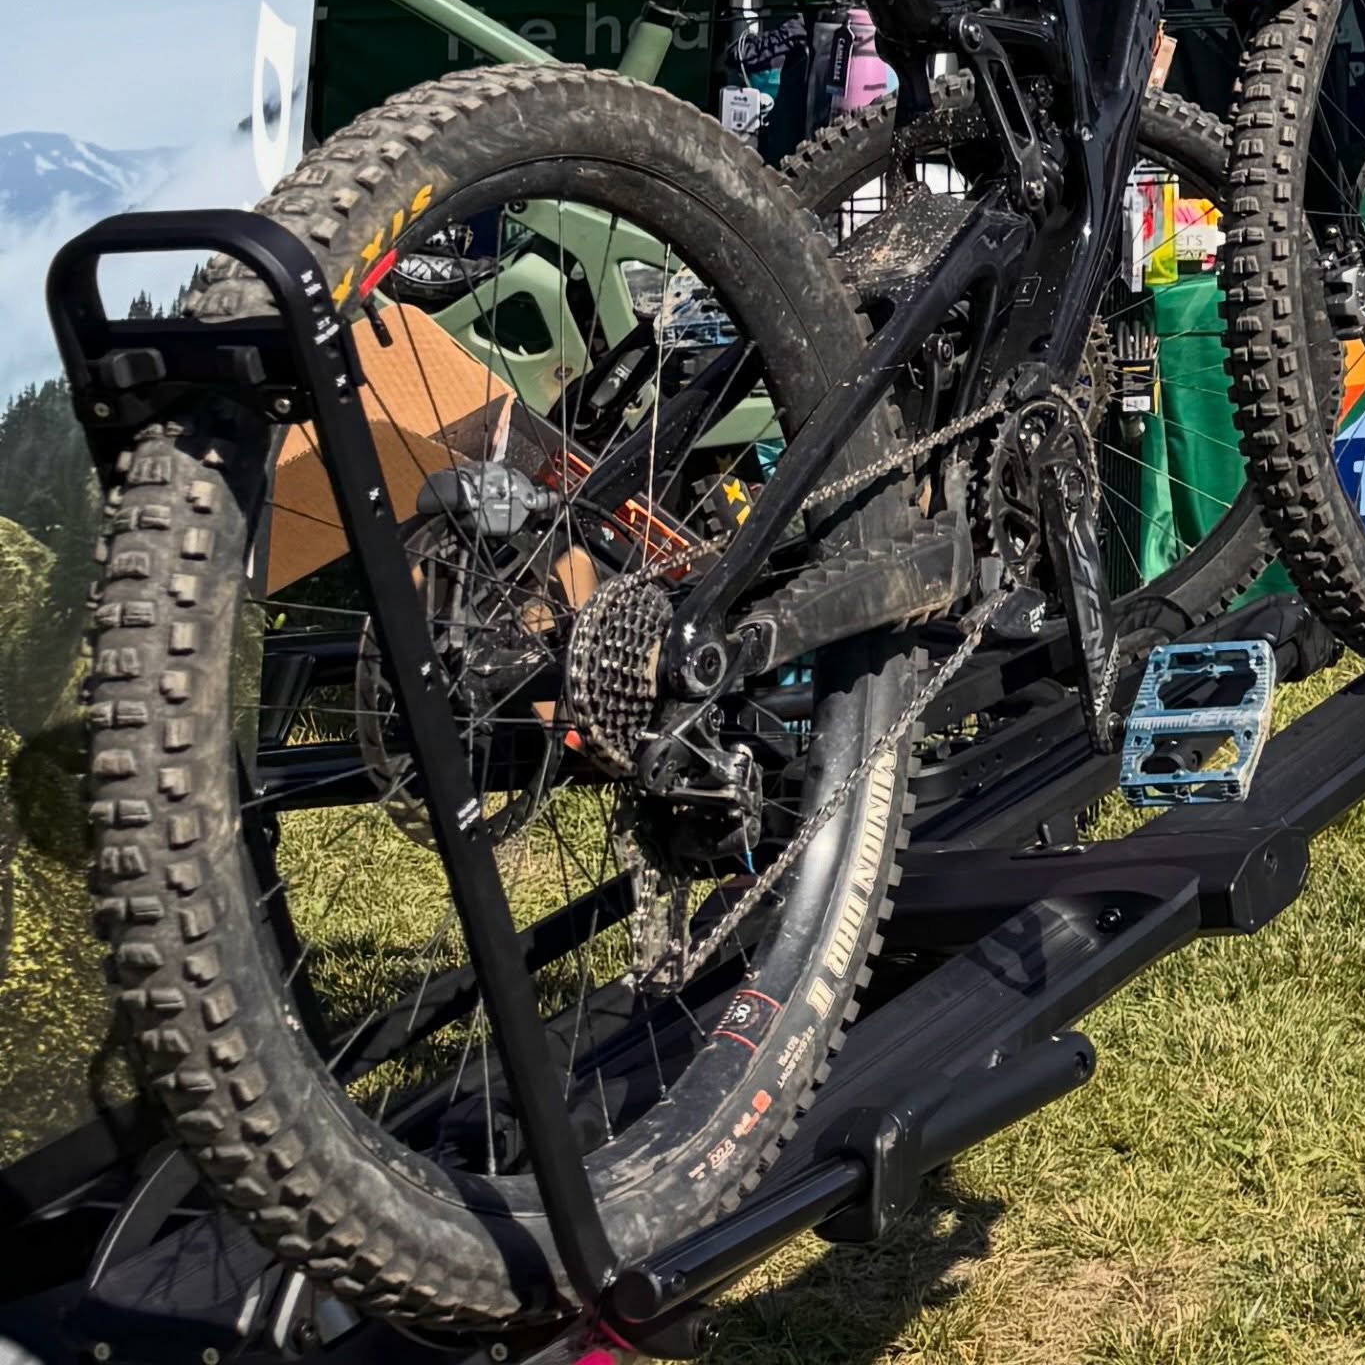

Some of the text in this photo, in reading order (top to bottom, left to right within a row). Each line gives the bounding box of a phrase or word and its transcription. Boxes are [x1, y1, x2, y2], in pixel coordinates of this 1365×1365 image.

[853, 749, 897, 894] MINION
[823, 894, 869, 979] DHR
[732, 1003, 752, 1023] 30
